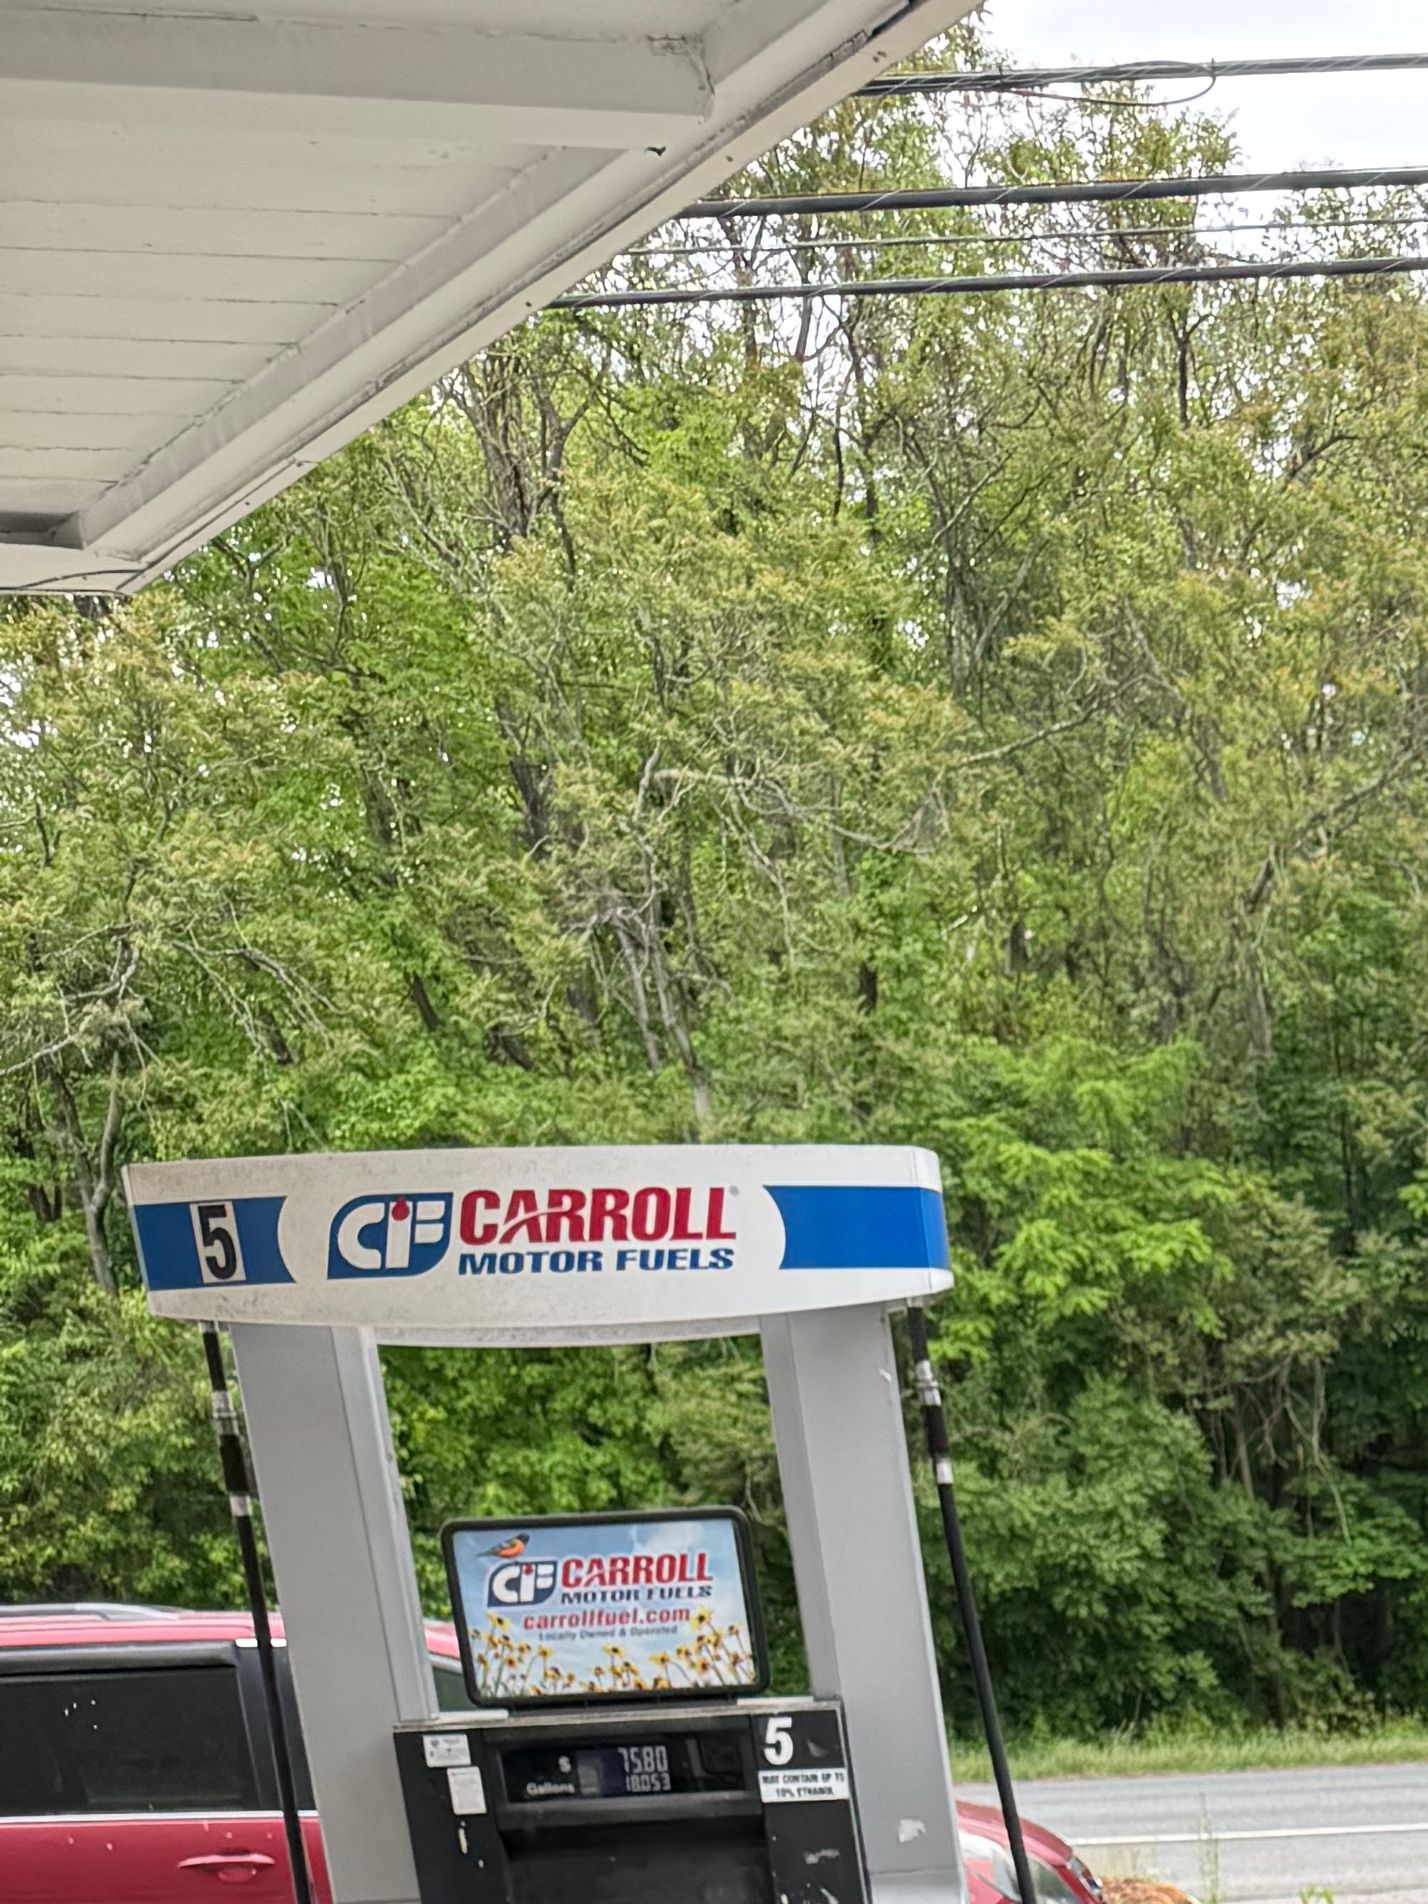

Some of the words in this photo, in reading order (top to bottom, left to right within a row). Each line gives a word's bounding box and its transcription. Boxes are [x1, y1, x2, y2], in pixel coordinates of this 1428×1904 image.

[459, 1186, 737, 1246] CARROLL
[198, 1204, 236, 1279] 5
[459, 1250, 603, 1276] MOTOR
[615, 1246, 735, 1272] FUELS
[561, 1552, 713, 1590] CARROLL
[561, 1587, 640, 1605] MOTOR
[647, 1584, 713, 1602] FUELS
[523, 1605, 691, 1631] carrollfuel.com
[764, 1716, 794, 1766] 5
[526, 1781, 575, 1796] Gallons
